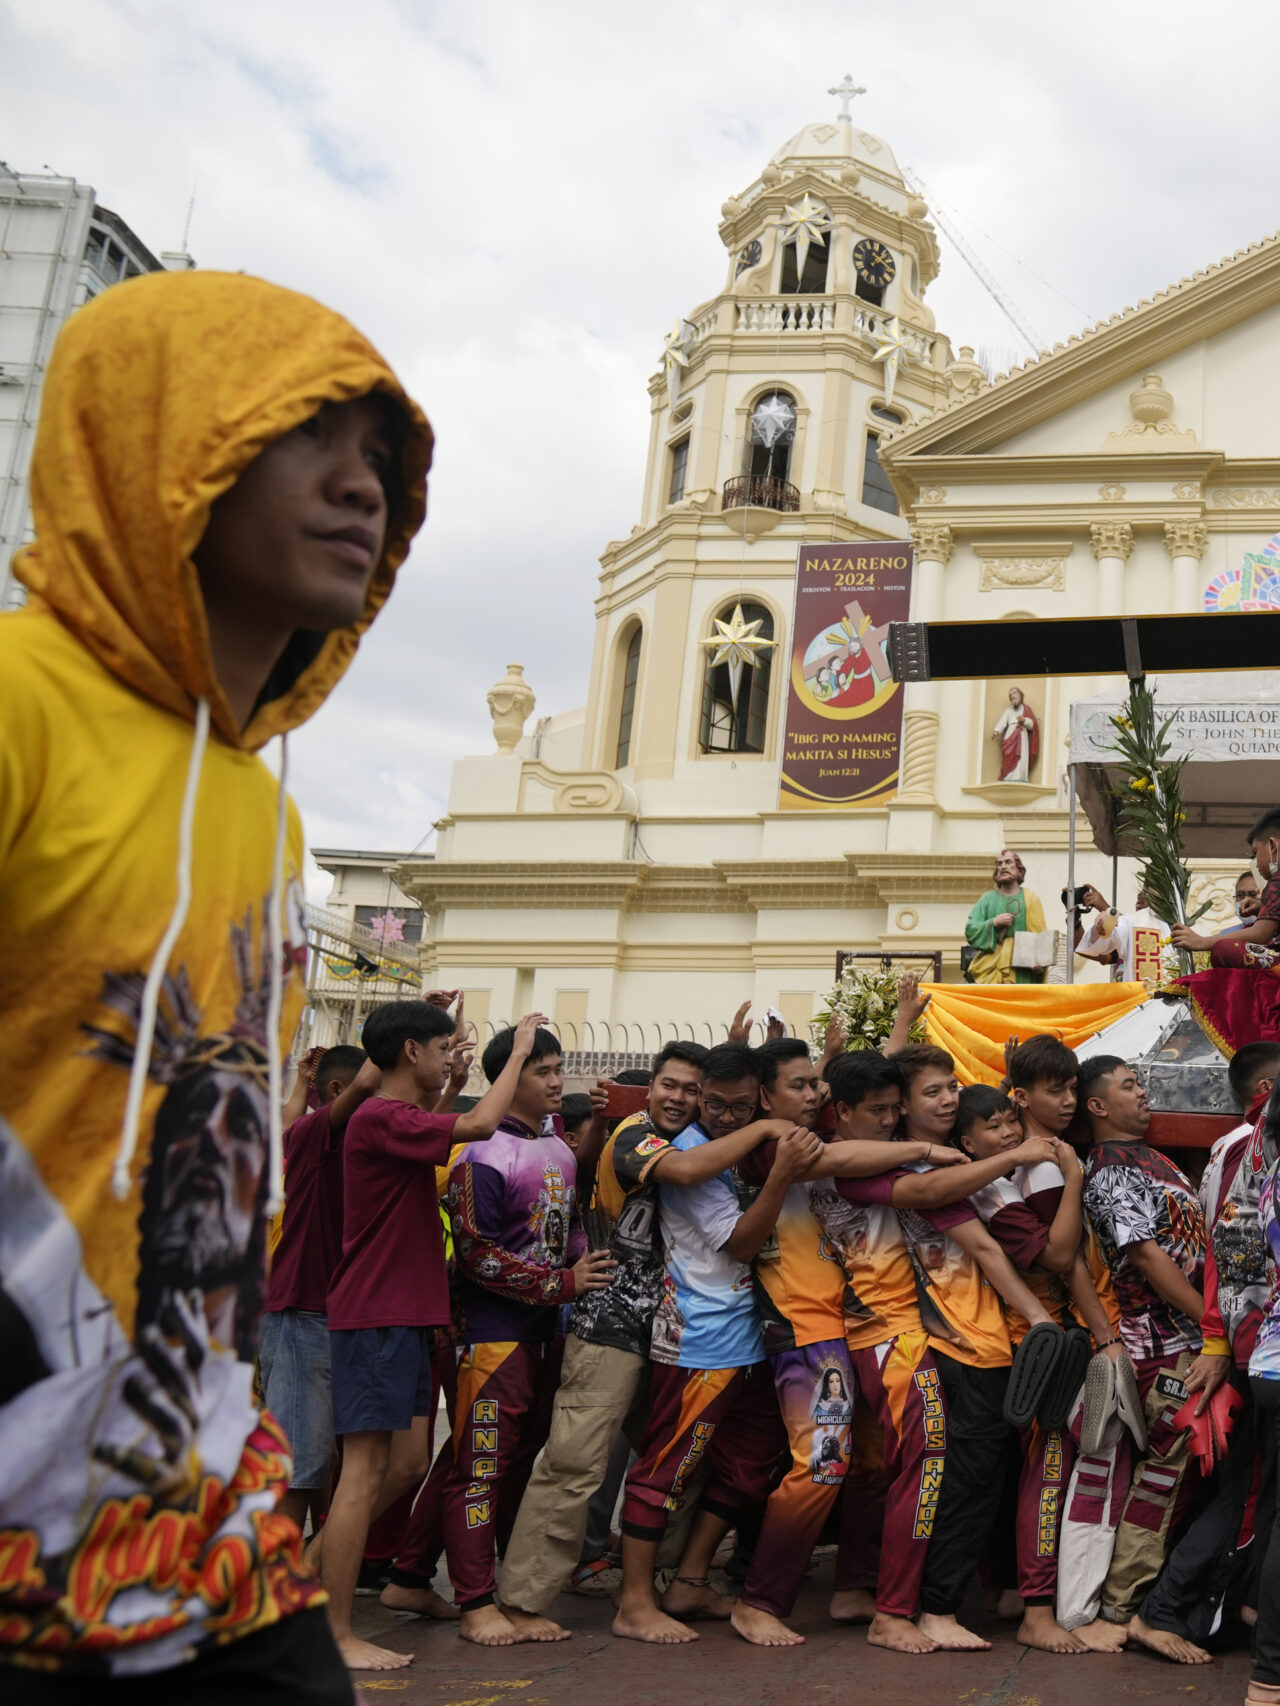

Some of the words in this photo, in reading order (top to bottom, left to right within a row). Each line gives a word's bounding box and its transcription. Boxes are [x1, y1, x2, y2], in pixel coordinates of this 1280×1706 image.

[805, 557, 908, 572] NAZARENO
[834, 573, 876, 586] 2024
[1153, 710, 1185, 723] NOR
[1189, 710, 1257, 723] BASILICA
[1259, 710, 1280, 723] OF
[822, 733, 840, 744] PO
[842, 732, 897, 743] NAMING
[1176, 727, 1200, 739] ST.
[1204, 728, 1245, 740] JOHN
[1252, 727, 1280, 739] THE
[785, 750, 835, 760] MAKITA
[837, 749, 849, 760] SI
[819, 767, 840, 778] JUAN
[841, 767, 860, 777] 12:21
[914, 1368, 946, 1450] HIJOS
[913, 1456, 946, 1539] ANPON
[1037, 1487, 1061, 1556] ANPON
